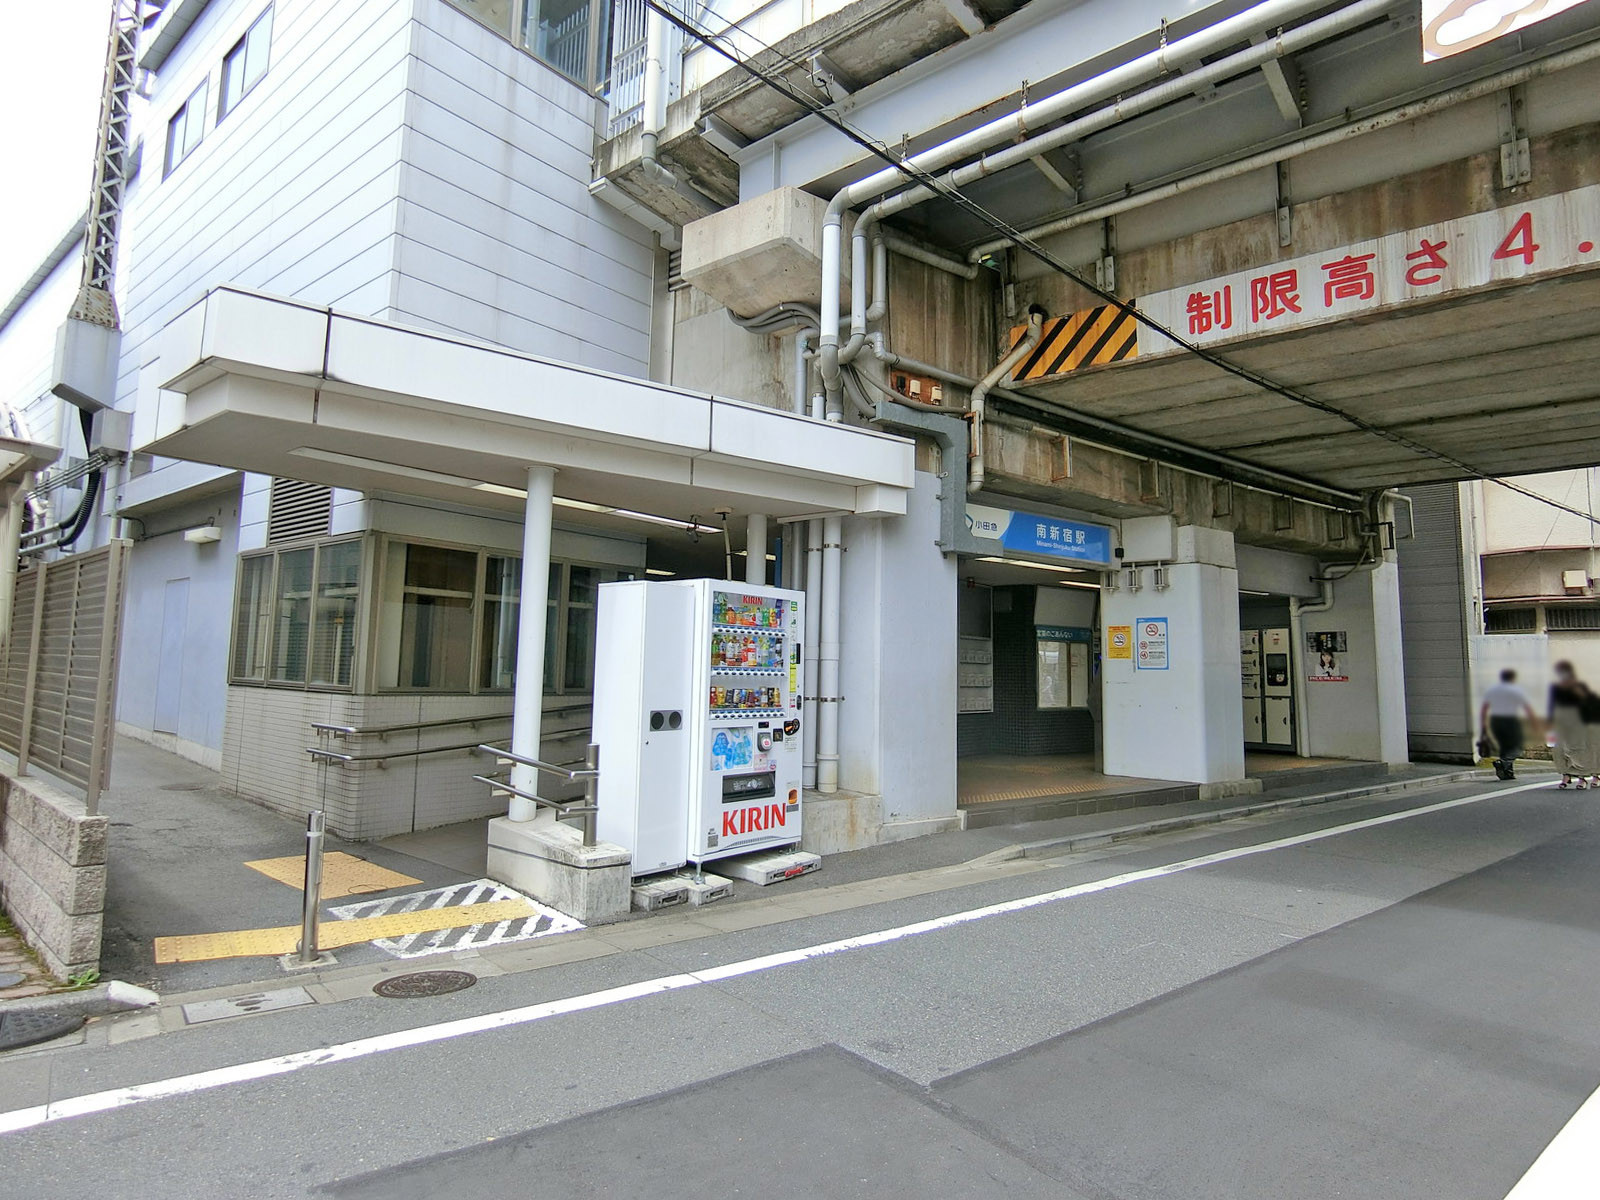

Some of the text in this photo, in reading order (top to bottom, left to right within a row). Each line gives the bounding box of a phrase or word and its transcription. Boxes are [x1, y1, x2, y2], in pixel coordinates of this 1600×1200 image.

[975, 520, 998, 532] 小田急
[1036, 523, 1086, 545] 南新宿駅
[742, 595, 763, 606] KIRIN
[722, 802, 786, 837] KIRIN
